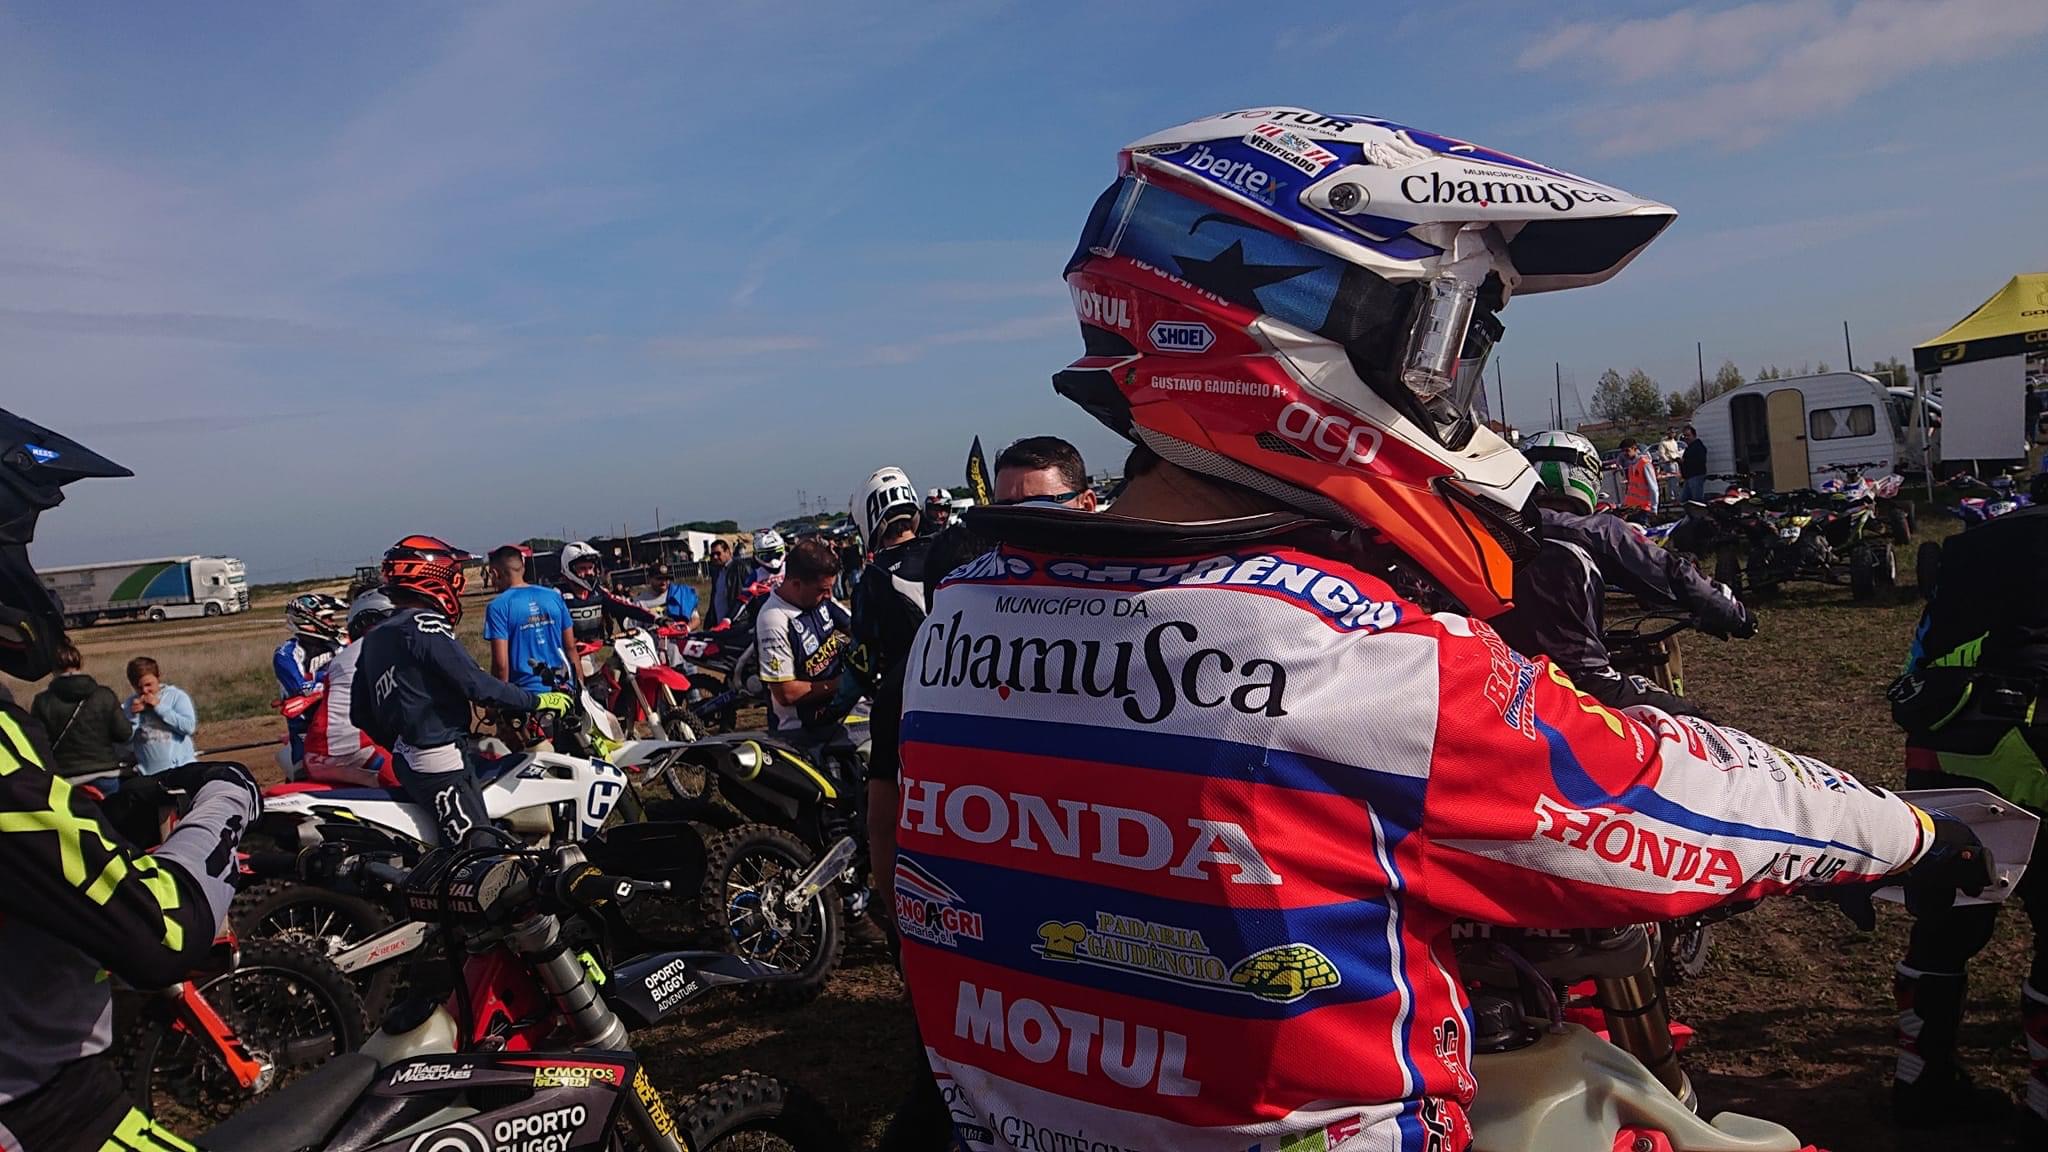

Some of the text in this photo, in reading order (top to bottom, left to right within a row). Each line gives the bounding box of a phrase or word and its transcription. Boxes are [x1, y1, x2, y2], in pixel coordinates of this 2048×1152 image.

[1250, 134, 1316, 172] VERIFICADO
[1184, 145, 1288, 206] ibertex
[1463, 168, 1543, 183] MUNICÍPIO DA
[1157, 327, 1204, 347] SHOEI
[1151, 375, 1289, 398] GUSTAVO GAUDÊNCIO A+
[1277, 401, 1384, 466] acp
[995, 595, 1149, 618] MUNICÍPIO DA
[900, 777, 1283, 886] HONDA
[1534, 805, 1743, 889] HONDA
[1098, 912, 1208, 951] PADARIA
[645, 958, 685, 989] OPORTO
[1088, 935, 1225, 981] GAUDÊNCIO
[651, 972, 685, 1002] BUGGY
[658, 980, 699, 1013] ADVENTURE
[954, 980, 1201, 1096] MOTUL
[494, 1106, 586, 1143] OPORTO
